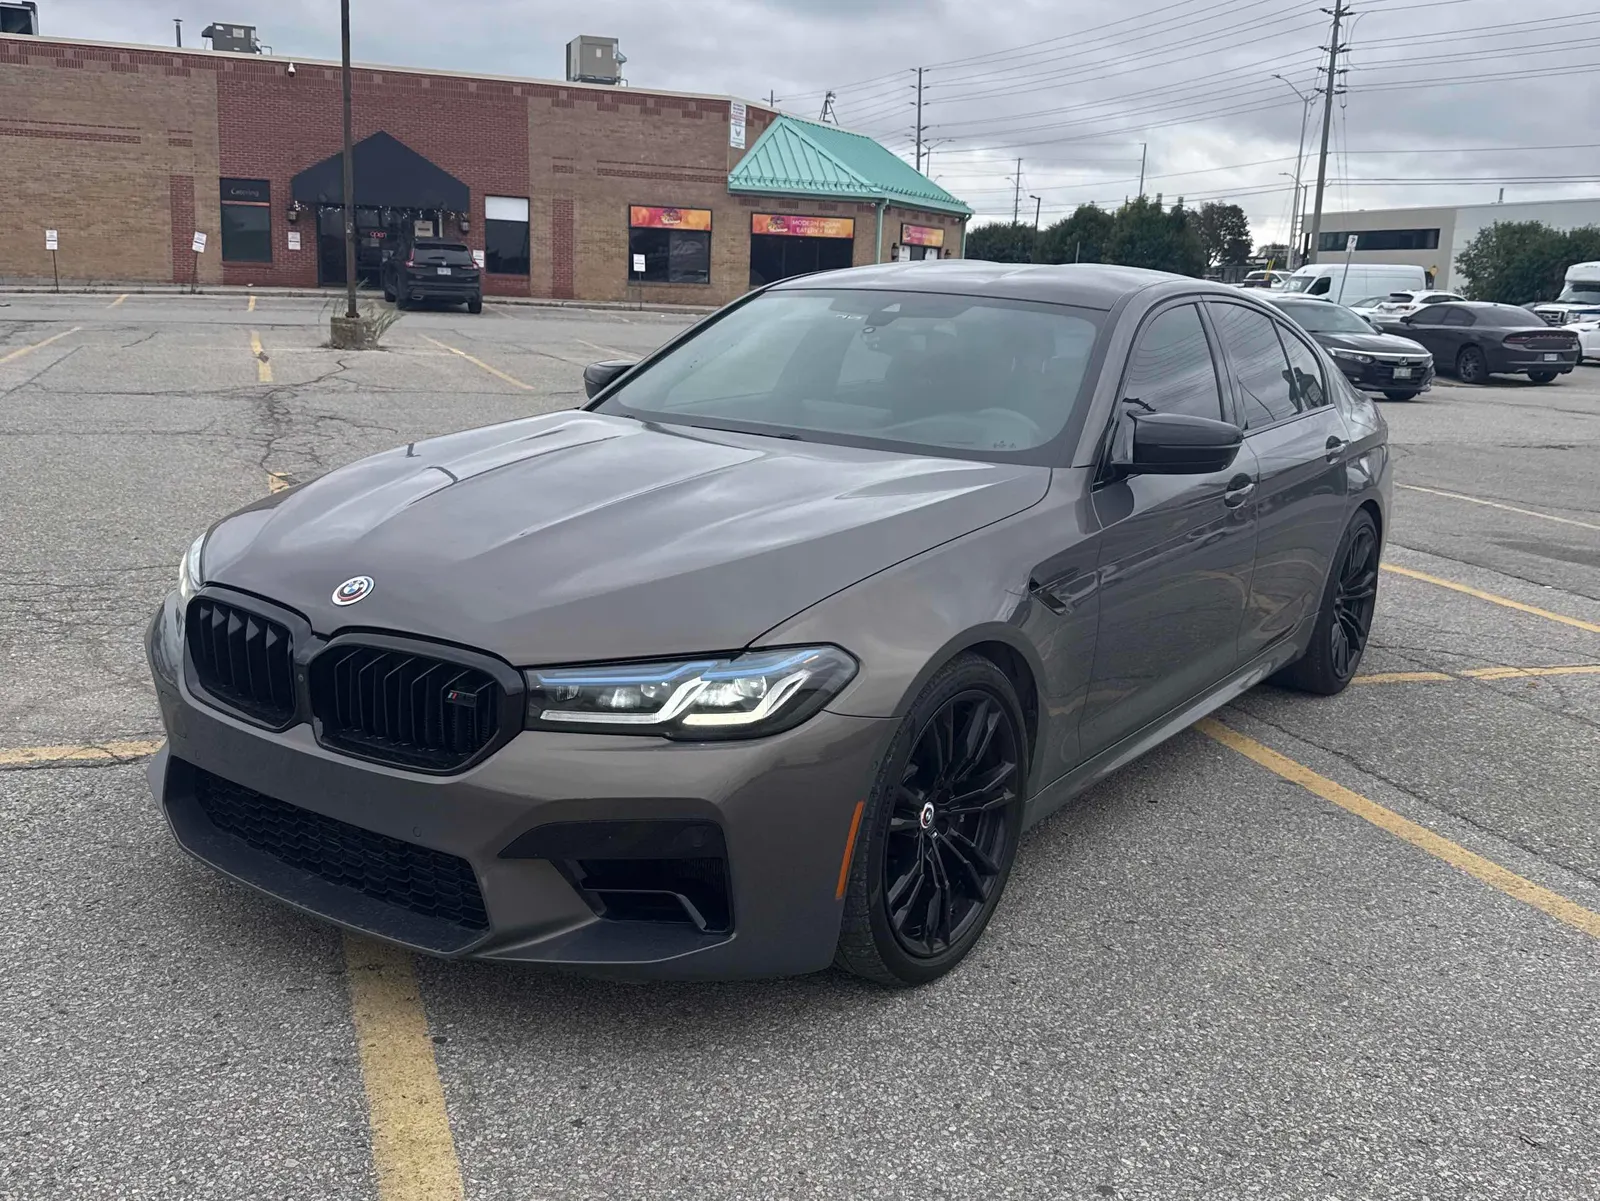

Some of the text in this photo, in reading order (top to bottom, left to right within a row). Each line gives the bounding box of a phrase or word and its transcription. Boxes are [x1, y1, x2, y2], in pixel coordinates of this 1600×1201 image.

[792, 219, 819, 227] MODERN
[796, 226, 819, 234] EATERY
[370, 231, 387, 239] open
